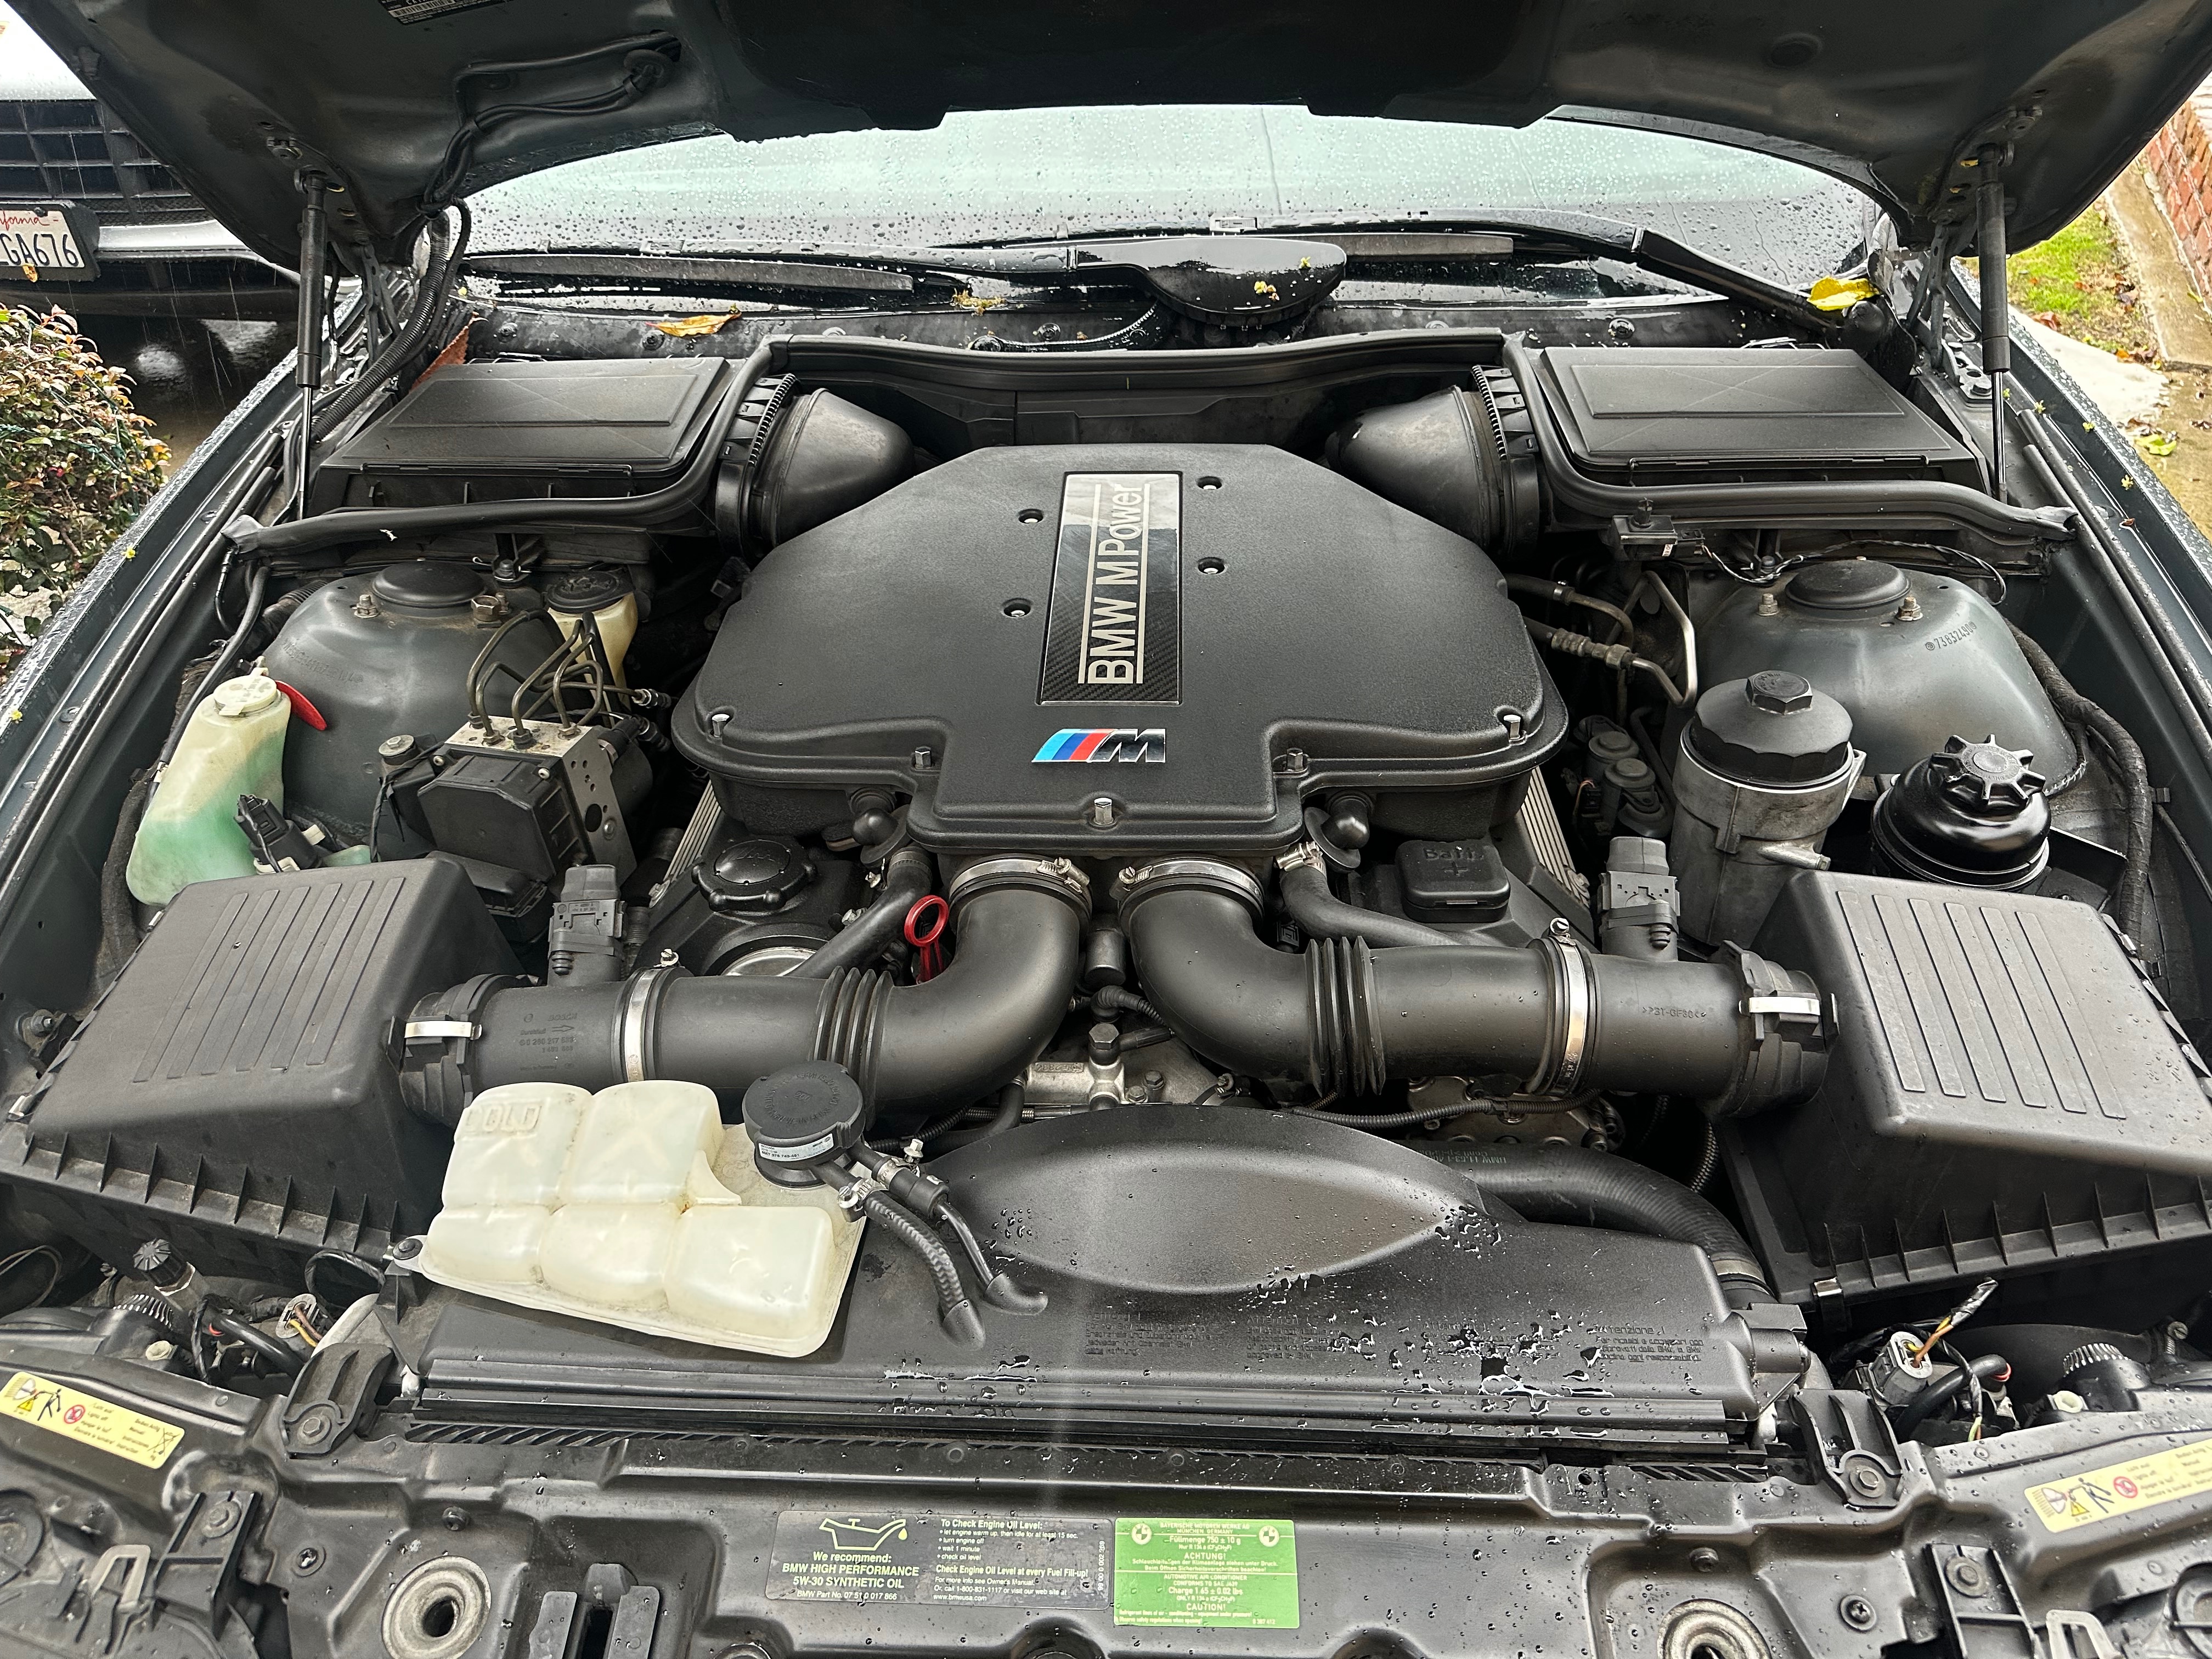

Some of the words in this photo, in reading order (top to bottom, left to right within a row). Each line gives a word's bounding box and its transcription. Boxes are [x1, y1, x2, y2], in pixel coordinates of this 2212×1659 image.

[0, 233, 78, 267] GA676
[1087, 596, 1137, 684] BMW
[465, 1105, 543, 1133] COLD
[941, 1519, 951, 1527] To
[952, 1519, 977, 1528] Check
[978, 1520, 1005, 1530] Engine
[1020, 1521, 1043, 1530] Level:
[1170, 1536, 1205, 1545] Füllmenge
[813, 1551, 828, 1561] We
[831, 1553, 892, 1563] recommend:
[782, 1563, 808, 1573] BMW
[810, 1564, 837, 1573] HIGH
[839, 1565, 919, 1576] PERFORMANCE
[936, 1565, 958, 1573] Check
[960, 1565, 984, 1576] Engine
[985, 1566, 996, 1575] Oil
[997, 1566, 1016, 1575] Level
[1017, 1567, 1025, 1576] at
[1026, 1568, 1045, 1578] every
[1047, 1567, 1062, 1577] Fuel
[1064, 1568, 1088, 1579] Fill-up!
[793, 1576, 823, 1586] 5W-30
[826, 1577, 884, 1588] SYNTHETIC
[887, 1578, 905, 1589] OIL
[1098, 1572, 1104, 1582] 00
[1097, 1582, 1104, 1591] 99
[1169, 1587, 1193, 1595] Charge
